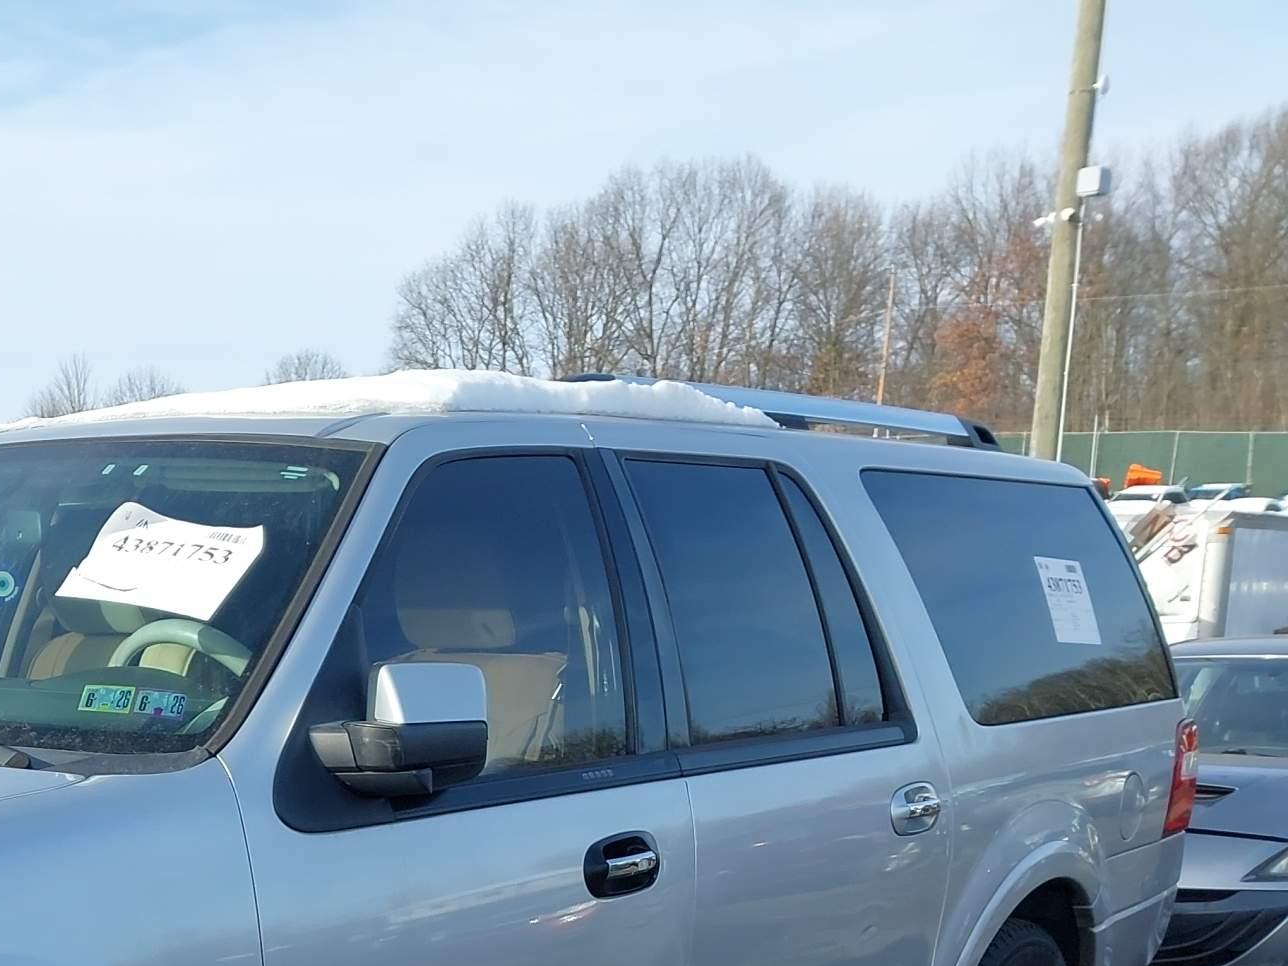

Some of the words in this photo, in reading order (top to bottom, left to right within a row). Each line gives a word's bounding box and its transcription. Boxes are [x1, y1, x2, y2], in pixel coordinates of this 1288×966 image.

[112, 535, 233, 565] 43871753
[85, 692, 95, 708] 6
[115, 690, 132, 709] 26
[138, 695, 149, 712] 6
[170, 695, 186, 715] 26
